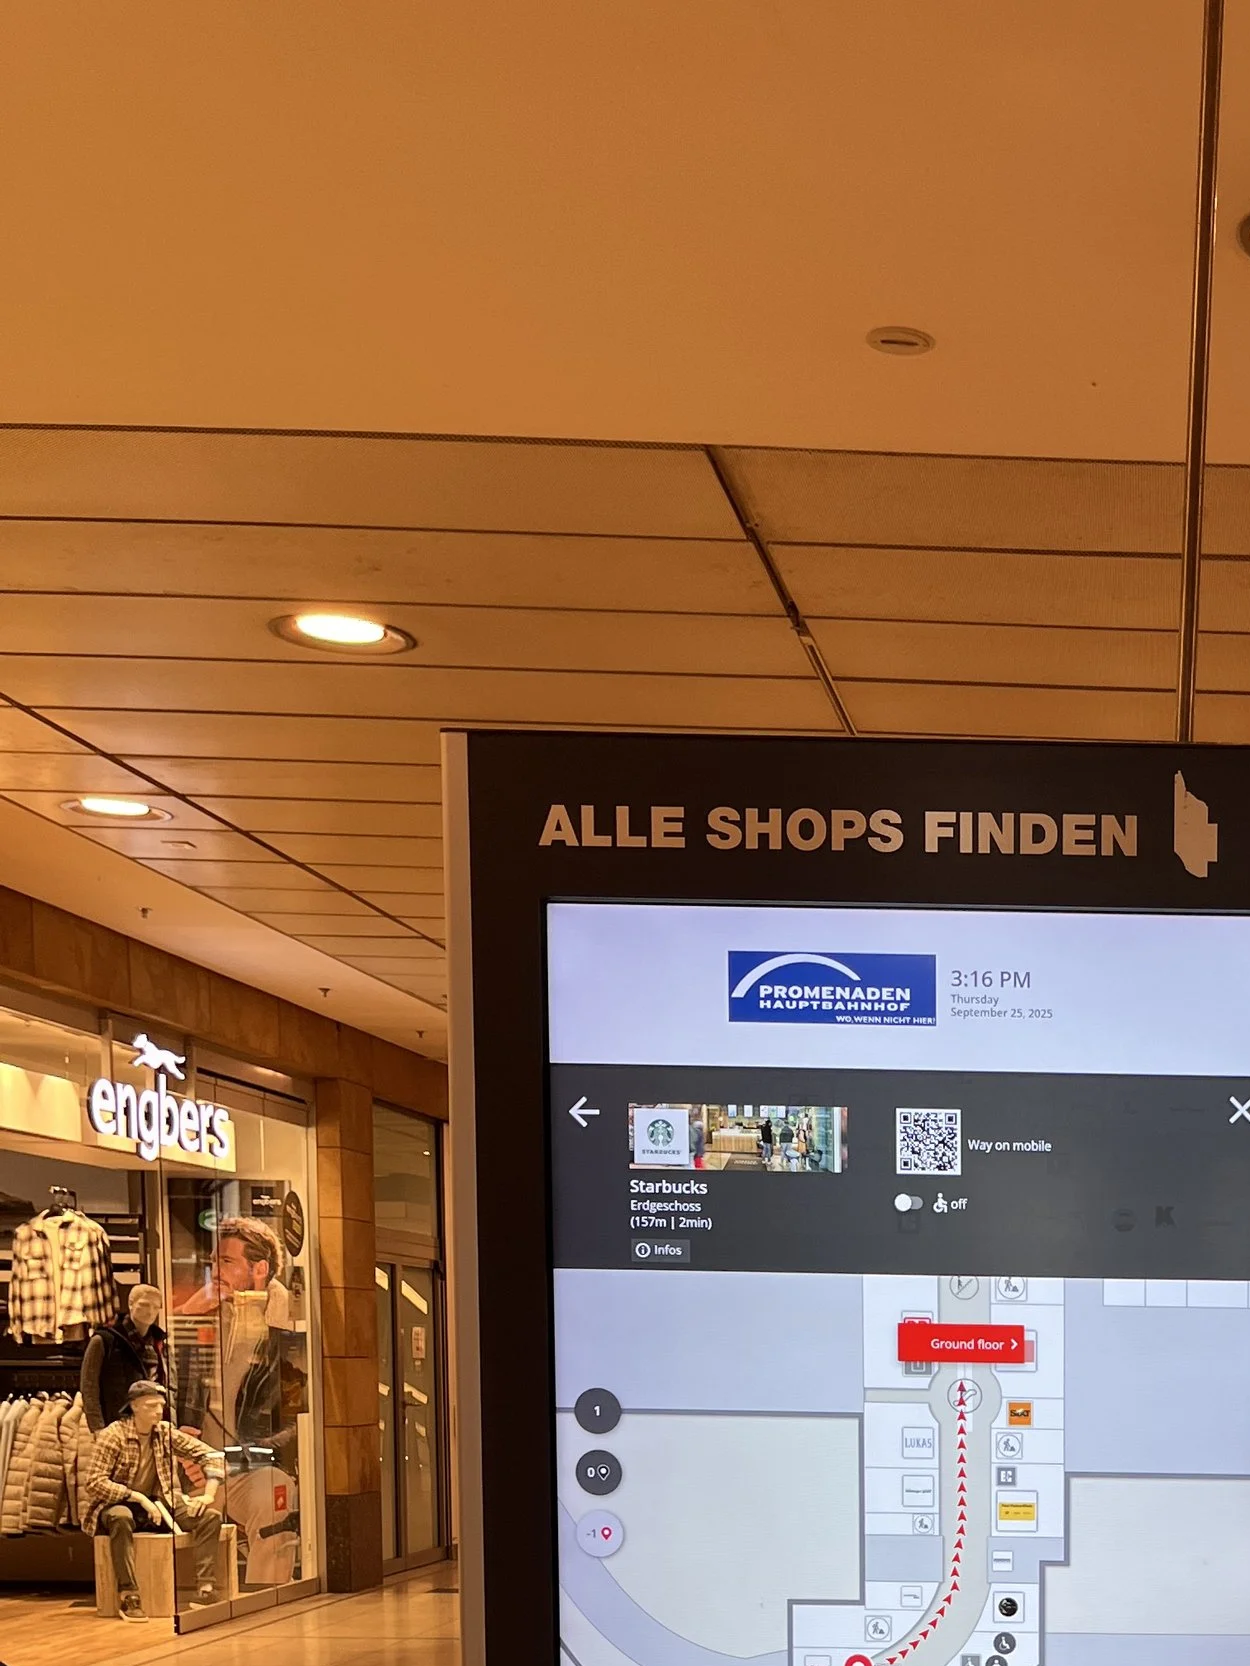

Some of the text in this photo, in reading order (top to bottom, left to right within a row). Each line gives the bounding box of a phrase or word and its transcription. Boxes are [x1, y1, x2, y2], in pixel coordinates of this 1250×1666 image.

[538, 804, 1138, 857] ALLE SHOPS FINDEN
[950, 970, 1031, 989] 3:16 PM
[759, 984, 911, 1001] PROMENADEN
[759, 1000, 911, 1012] HAUPTBAHNHOF
[950, 994, 999, 1007] Thursday
[883, 1016, 911, 1024] NICHT
[950, 1008, 1053, 1020] September 25, 2025
[90, 1074, 231, 1161] engbers
[967, 1138, 1052, 1153] Way on mobile
[629, 1179, 708, 1194] Starbucks
[630, 1199, 701, 1214] Erdgeschoss
[950, 1197, 968, 1210] off
[630, 1215, 667, 1230] (157m
[678, 1216, 713, 1231] 2min)
[654, 1244, 683, 1256] Infos
[930, 1338, 1005, 1350] Ground floor
[593, 1405, 601, 1417] 1
[904, 1437, 933, 1449] LUKAS
[587, 1467, 595, 1478] 0
[586, 1528, 597, 1539] -1
